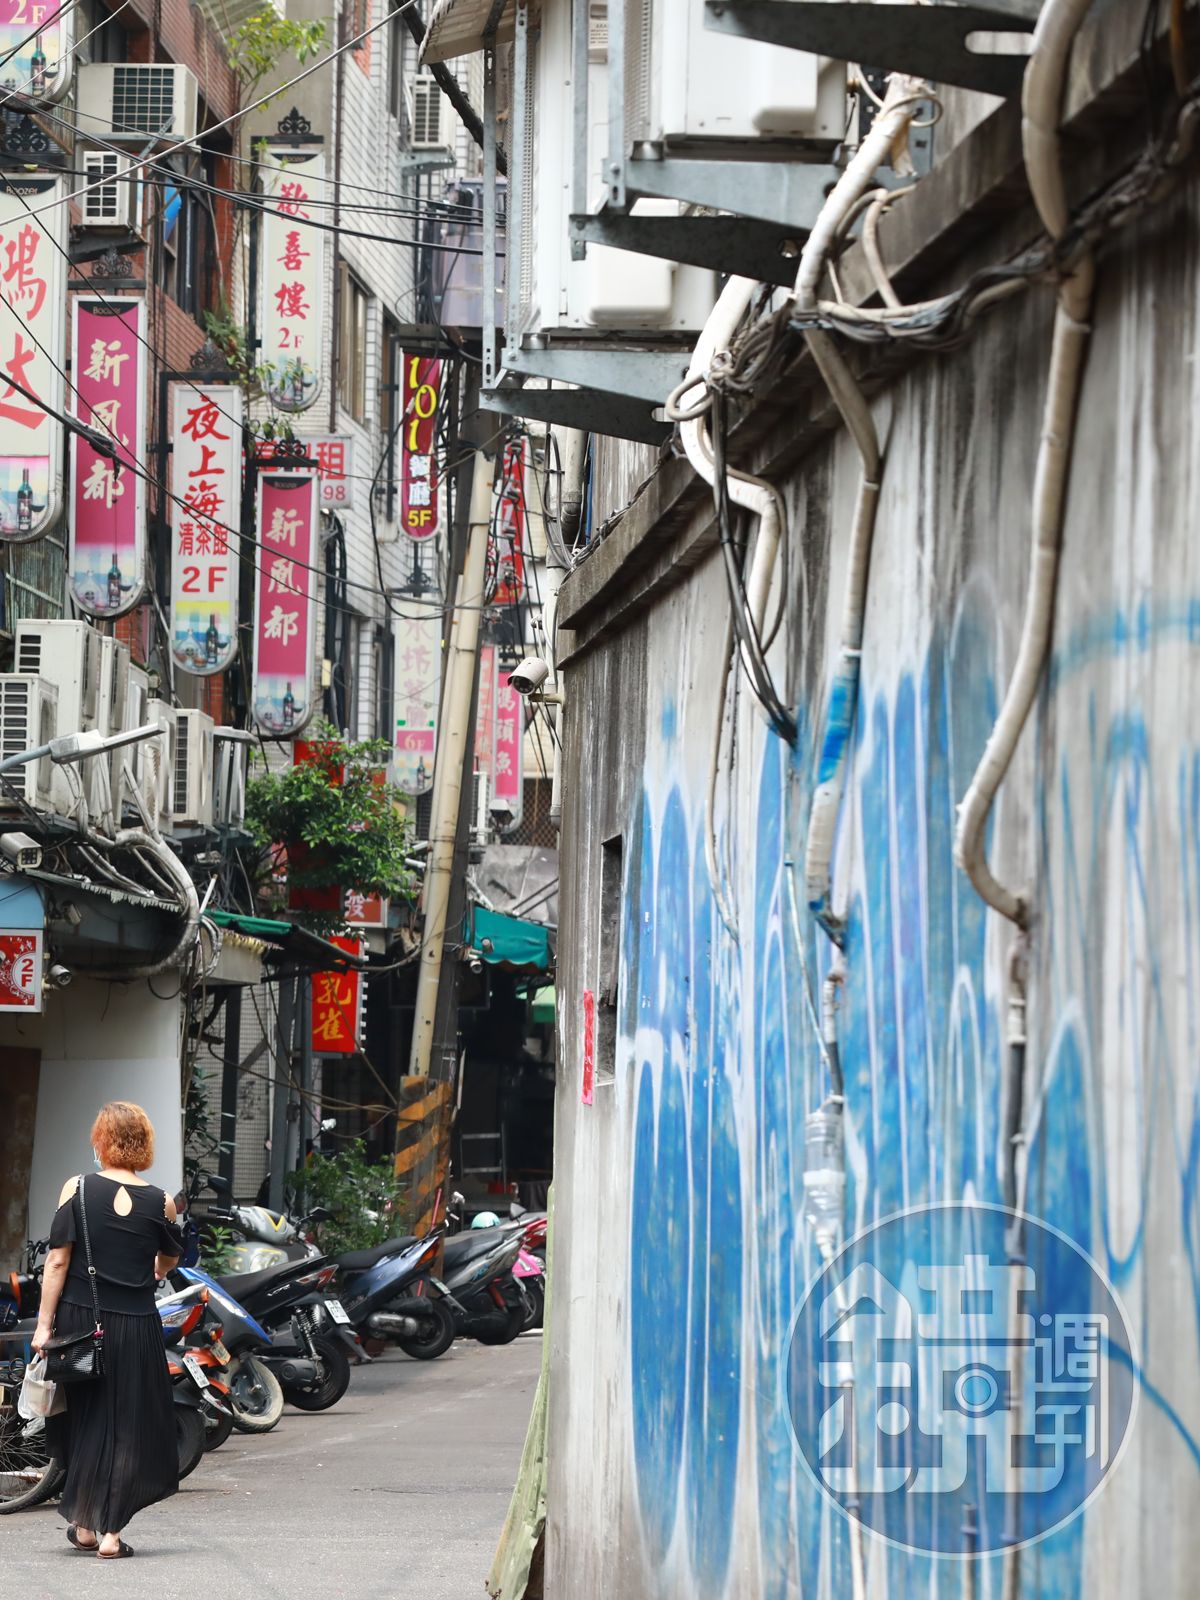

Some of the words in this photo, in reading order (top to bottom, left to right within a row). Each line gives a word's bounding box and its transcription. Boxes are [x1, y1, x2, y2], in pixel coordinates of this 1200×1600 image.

[278, 327, 304, 348] 2F
[409, 356, 437, 451] 101
[181, 396, 230, 519] 夜上海
[408, 510, 432, 527] 5F
[182, 566, 227, 593] 2F
[21, 958, 34, 987] 2F
